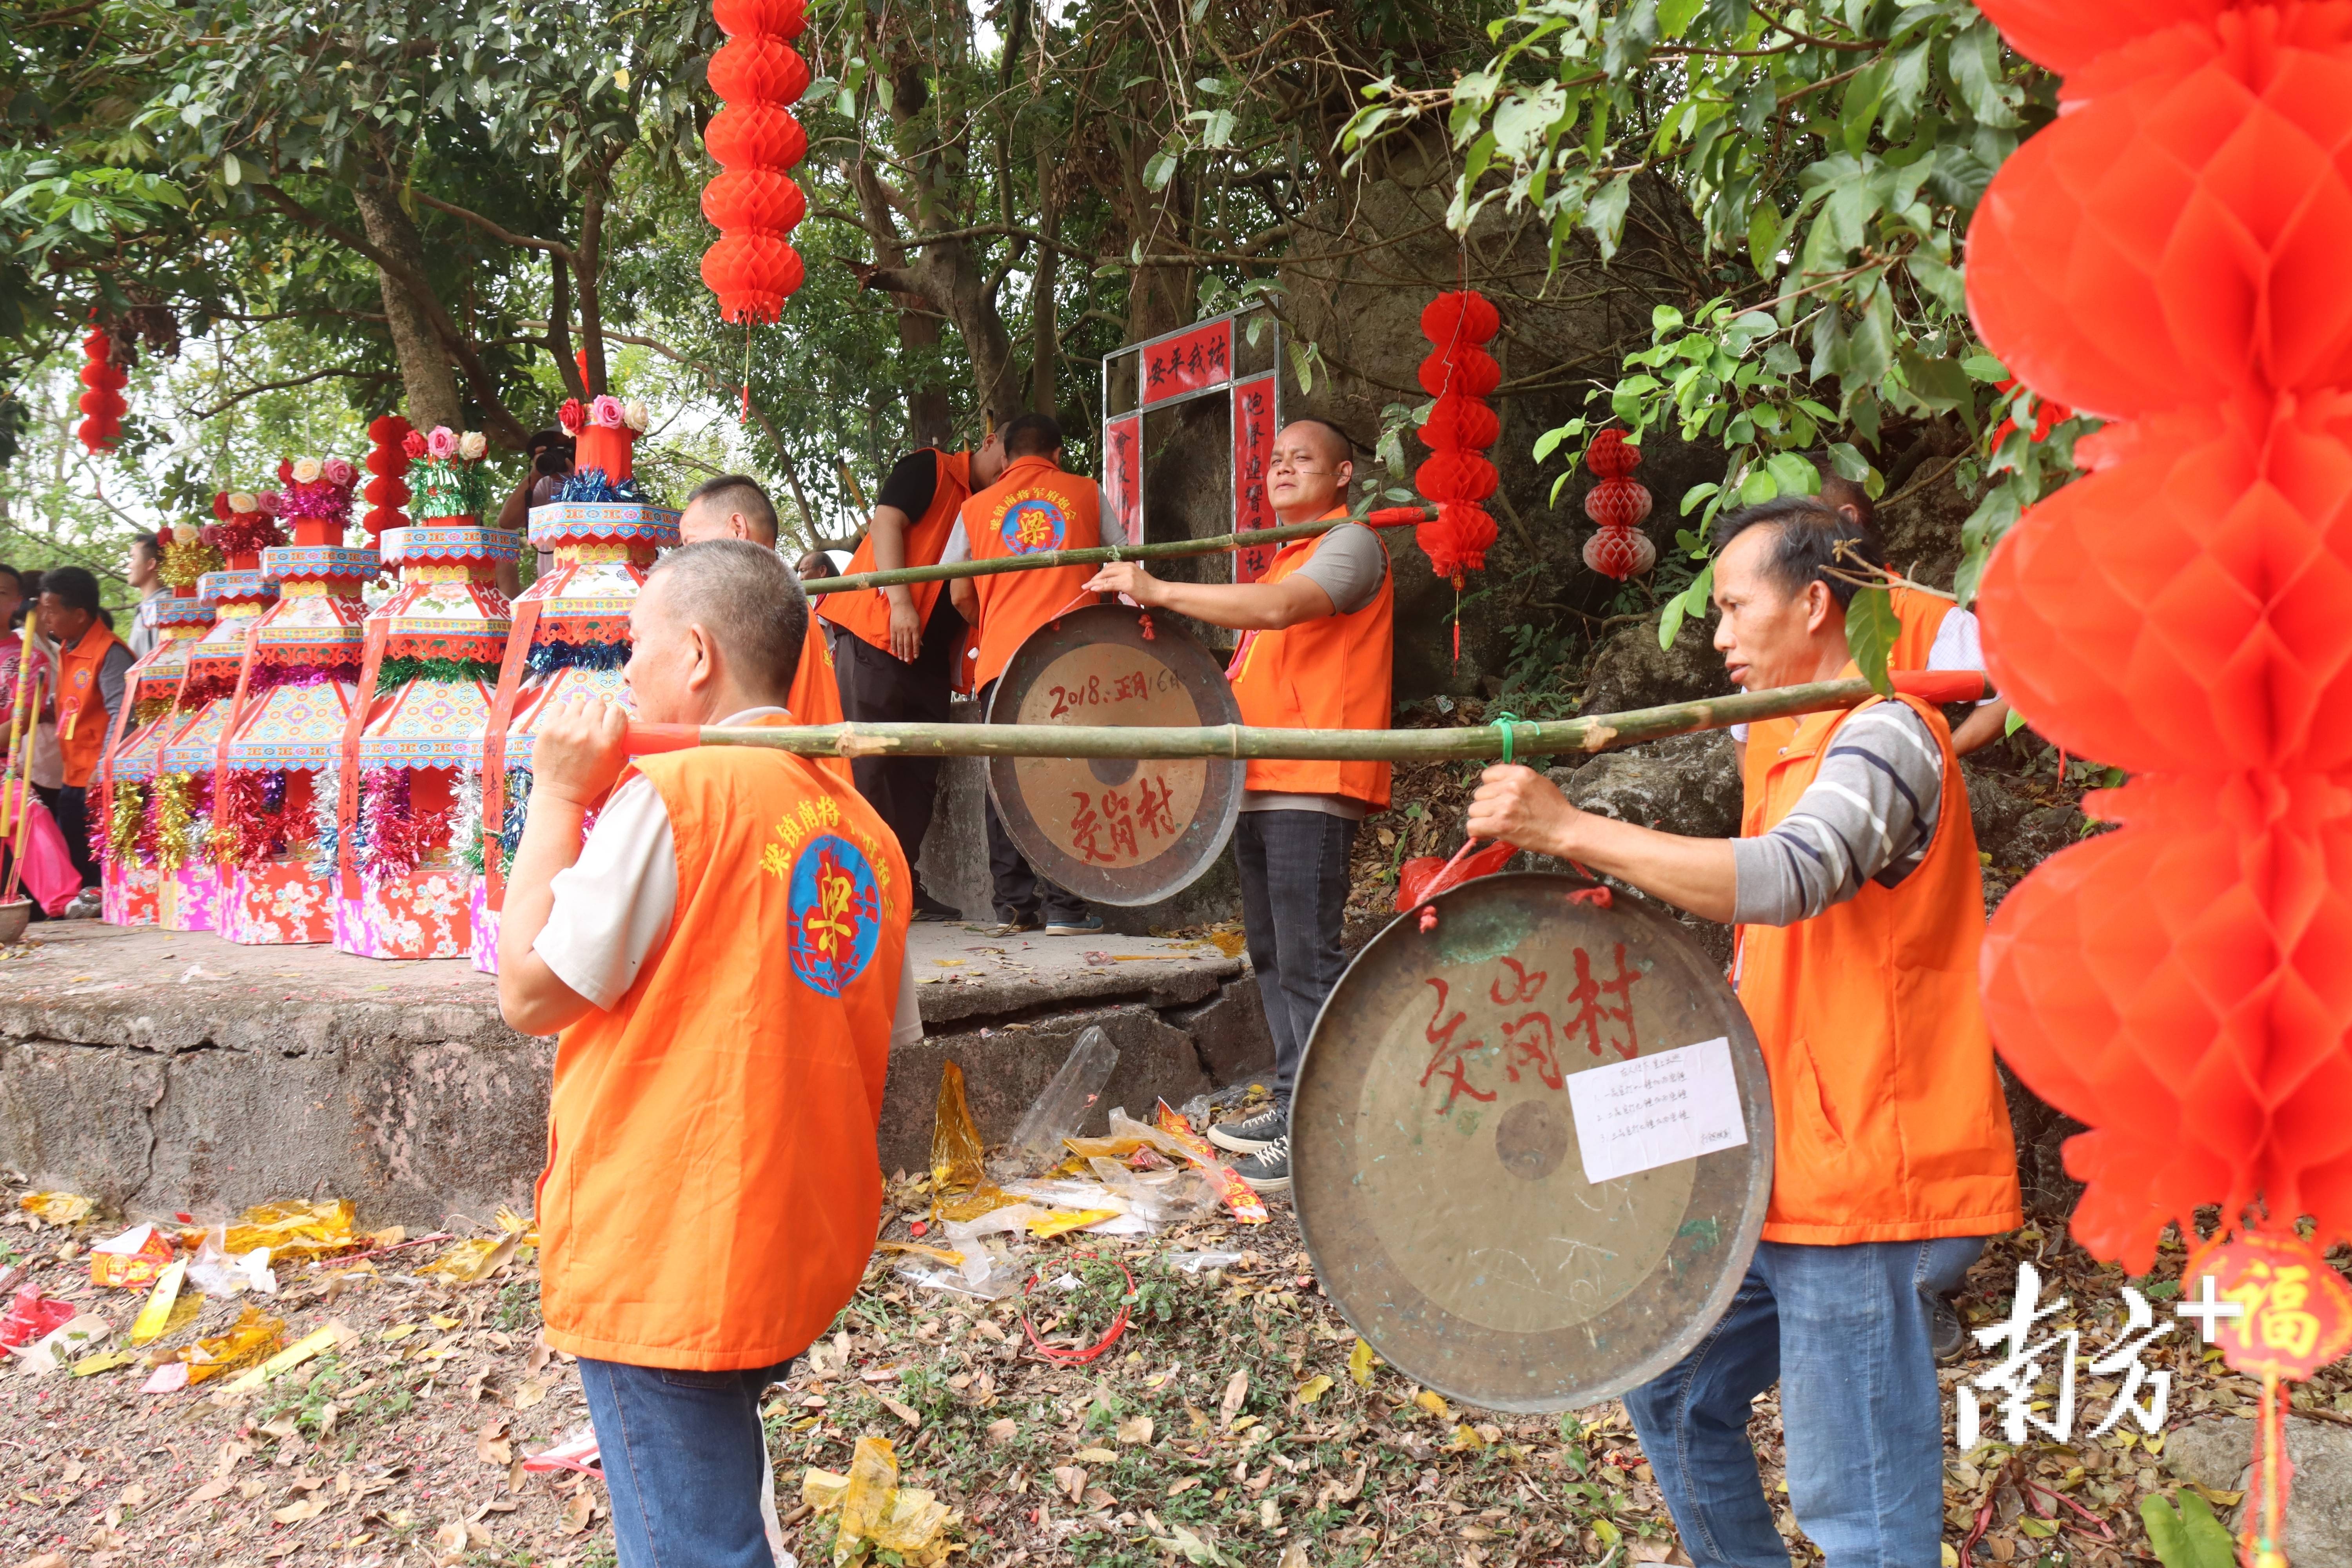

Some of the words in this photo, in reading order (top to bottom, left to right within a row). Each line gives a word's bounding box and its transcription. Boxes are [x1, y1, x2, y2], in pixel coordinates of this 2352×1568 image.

[989, 487, 1077, 531] 梁镇南将军府炮会
[1017, 511, 1051, 545] 梁
[2219, 1258, 2321, 1359] 福
